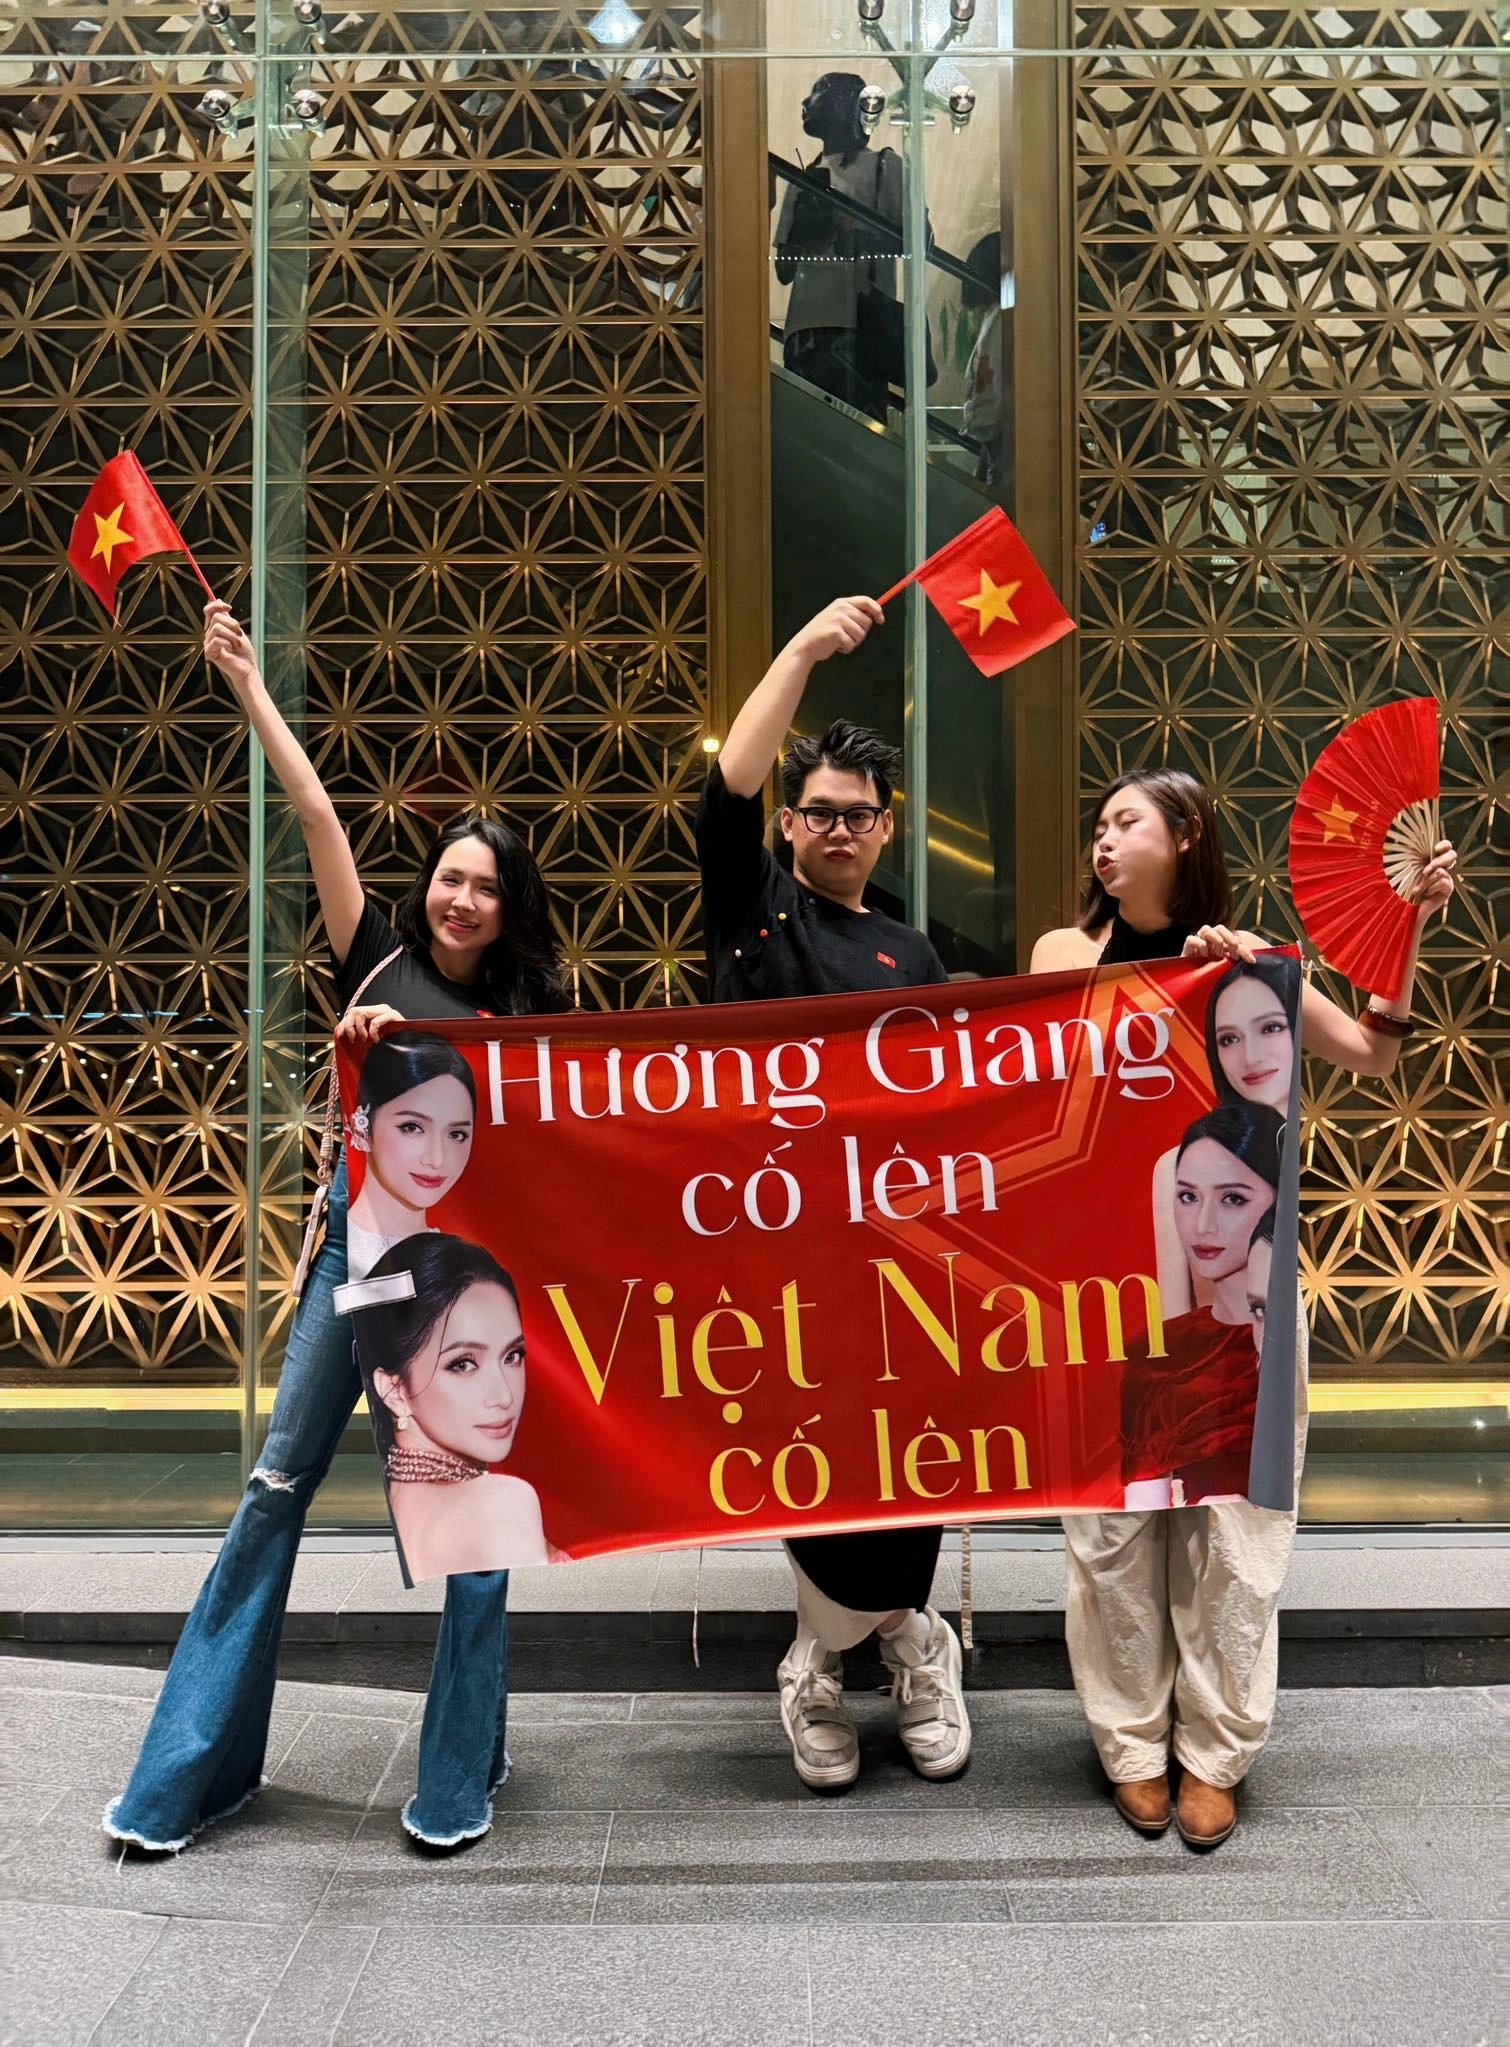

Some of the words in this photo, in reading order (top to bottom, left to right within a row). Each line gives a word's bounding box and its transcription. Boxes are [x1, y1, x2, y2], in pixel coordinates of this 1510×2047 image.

[486, 1036, 826, 1129] Hương
[866, 1006, 1175, 1100] Giang
[682, 1142, 802, 1236] cố
[843, 1136, 998, 1223] lên
[543, 1278, 822, 1424] Việt
[868, 1253, 1168, 1381] Nam
[709, 1414, 830, 1516] cố
[872, 1409, 1032, 1502] lên
